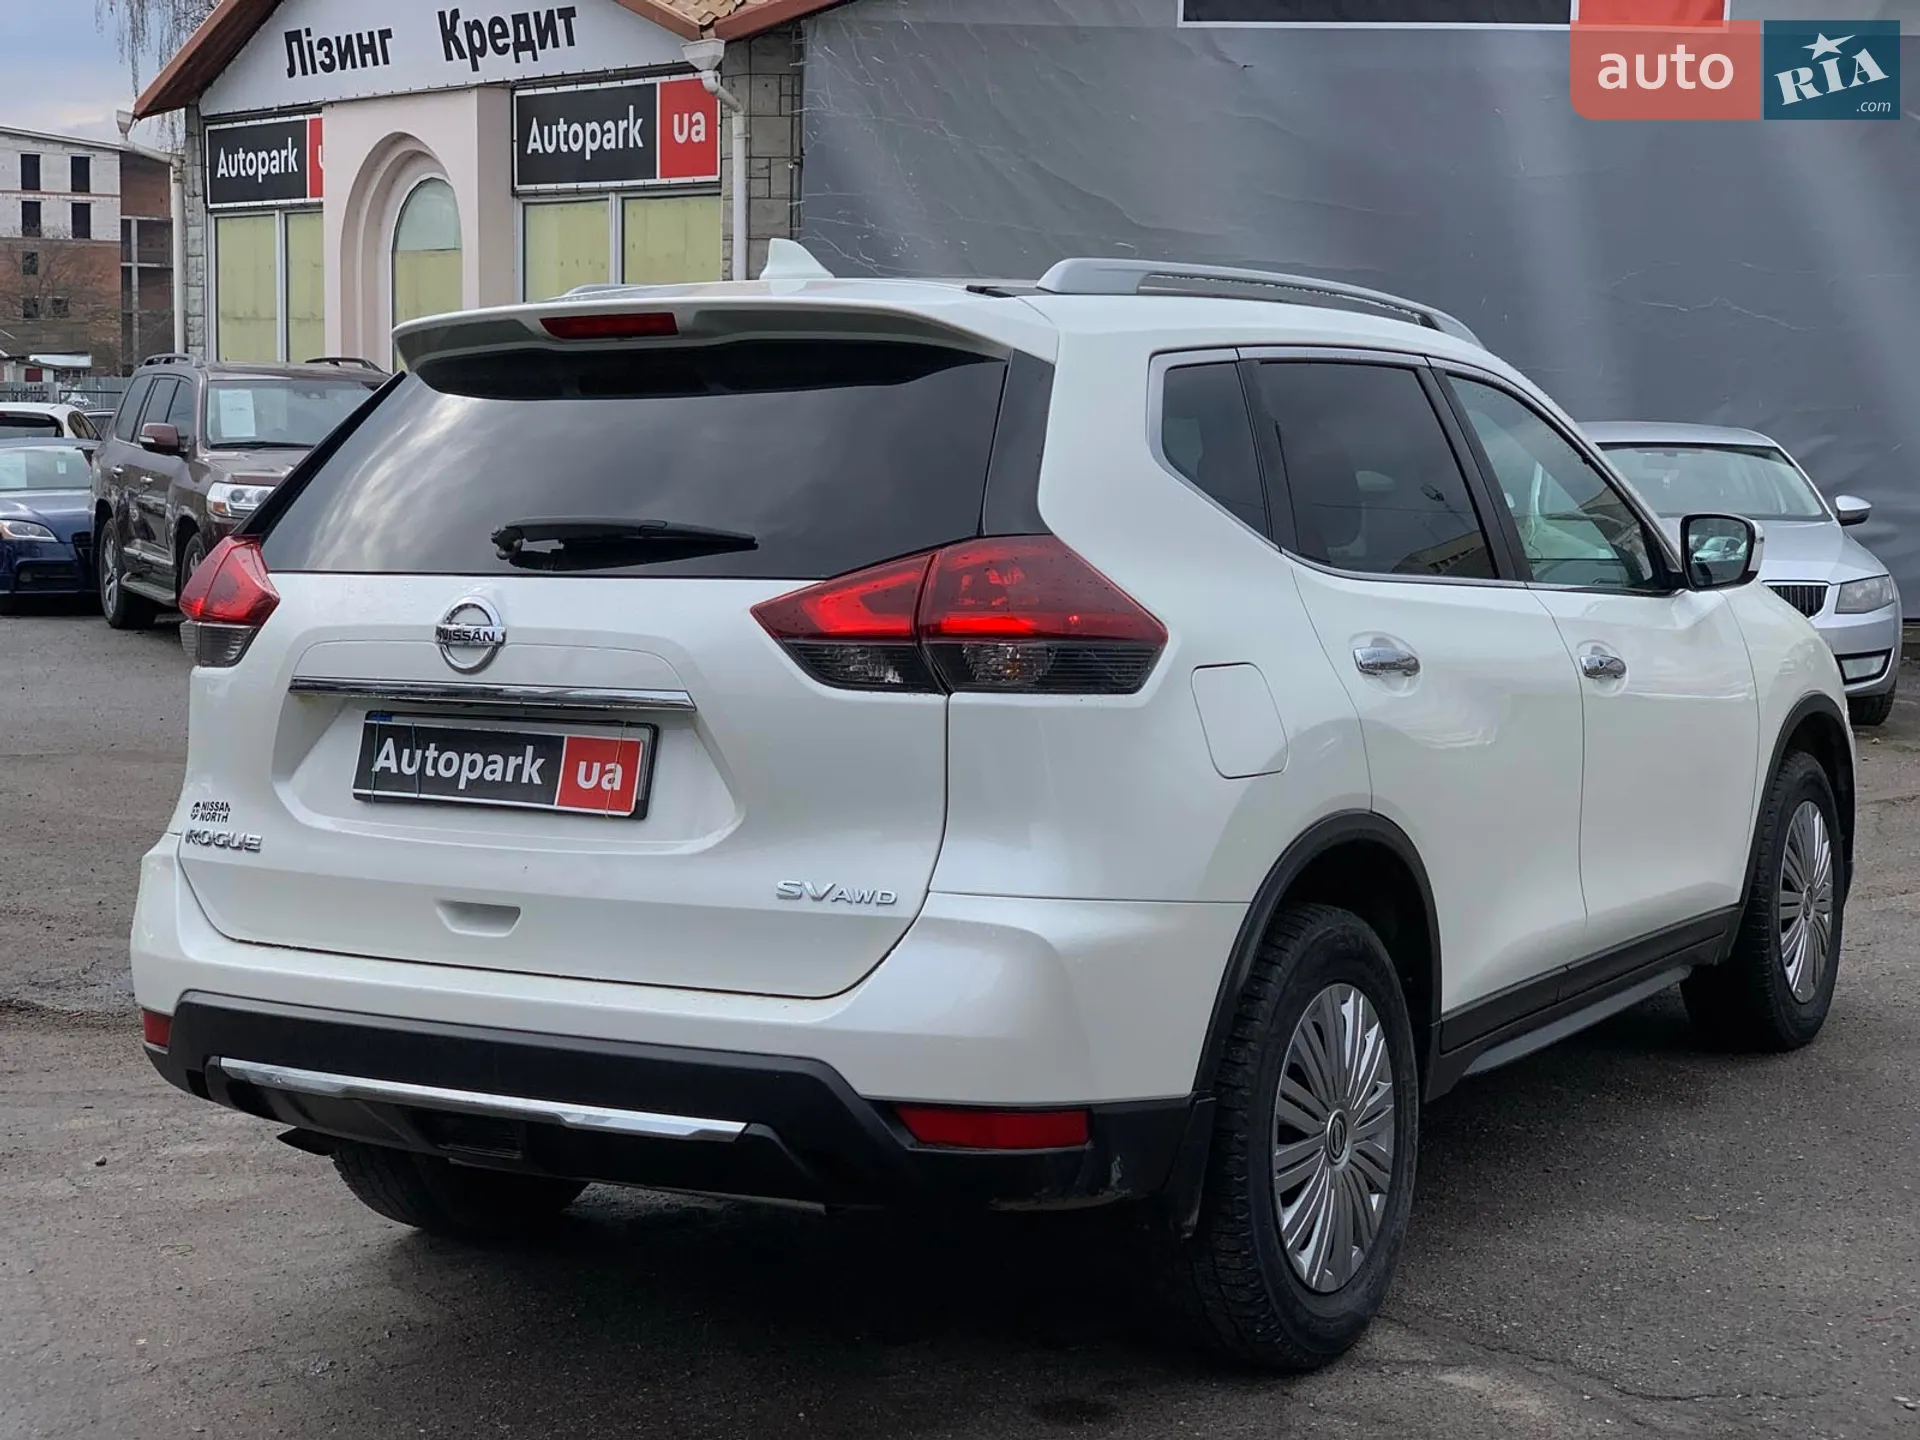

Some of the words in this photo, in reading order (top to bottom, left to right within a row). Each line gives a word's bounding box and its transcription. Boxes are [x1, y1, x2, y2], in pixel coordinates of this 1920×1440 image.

[284, 27, 393, 78] Лізинг
[437, 6, 577, 72] Кредит
[526, 105, 644, 161] Autopark
[672, 111, 706, 144] ua
[216, 136, 299, 184] Autopark
[439, 628, 496, 642] NISSAN
[373, 737, 546, 790] Autopark
[576, 760, 623, 791] ua
[199, 811, 229, 823] NORTH
[201, 801, 231, 813] NISSAN
[184, 829, 263, 853] ROGUE
